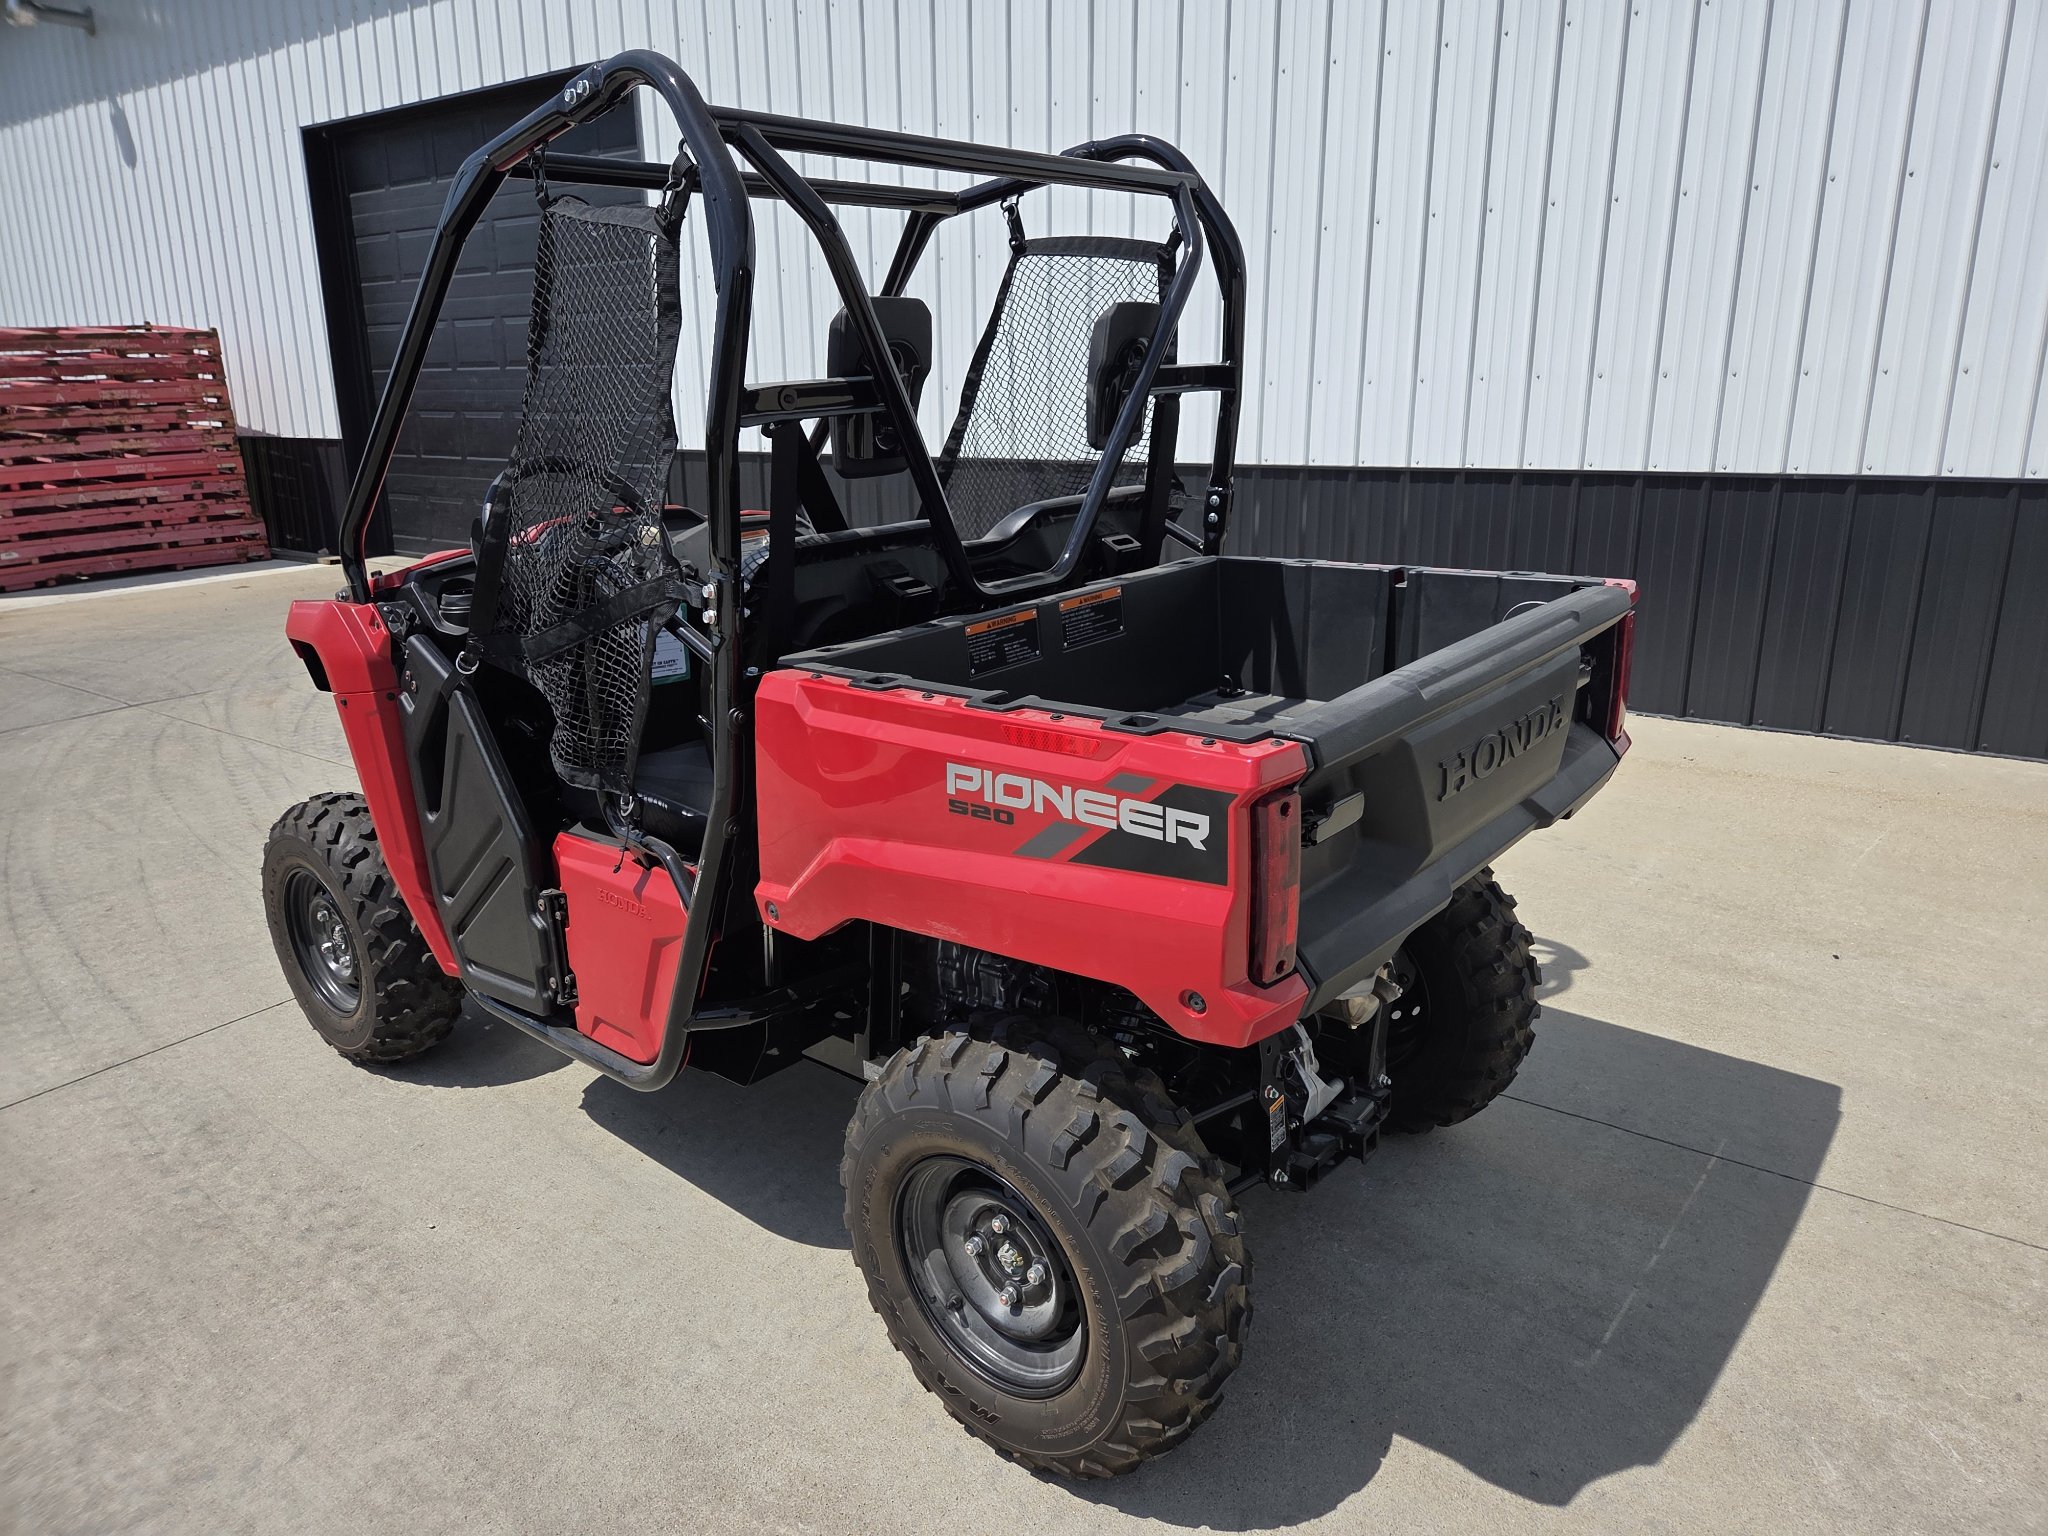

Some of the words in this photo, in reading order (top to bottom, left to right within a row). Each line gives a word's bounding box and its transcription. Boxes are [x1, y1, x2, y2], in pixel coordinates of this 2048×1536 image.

[991, 616, 1017, 627] WARNING
[1438, 693, 1569, 802] HONDA
[946, 762, 1210, 851] PIONEER
[948, 798, 1014, 825] 520
[597, 888, 652, 921] HONDA
[865, 1243, 1002, 1425] MAXXIS
